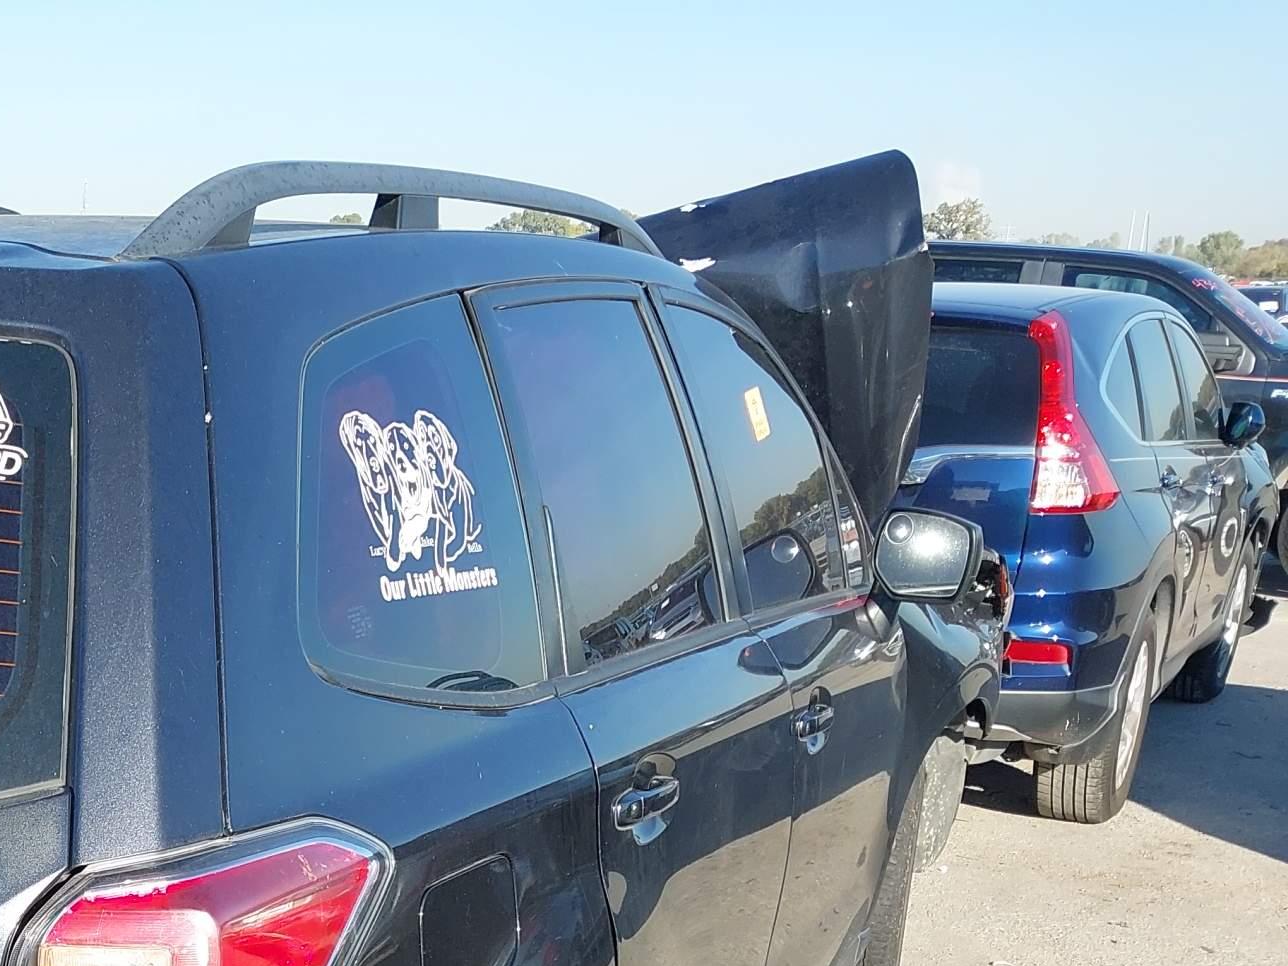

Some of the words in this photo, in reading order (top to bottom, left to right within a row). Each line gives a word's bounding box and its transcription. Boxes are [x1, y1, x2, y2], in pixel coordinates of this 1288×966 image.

[380, 575, 406, 601] Our
[406, 569, 443, 598] Little
[442, 566, 498, 592] Monsters
